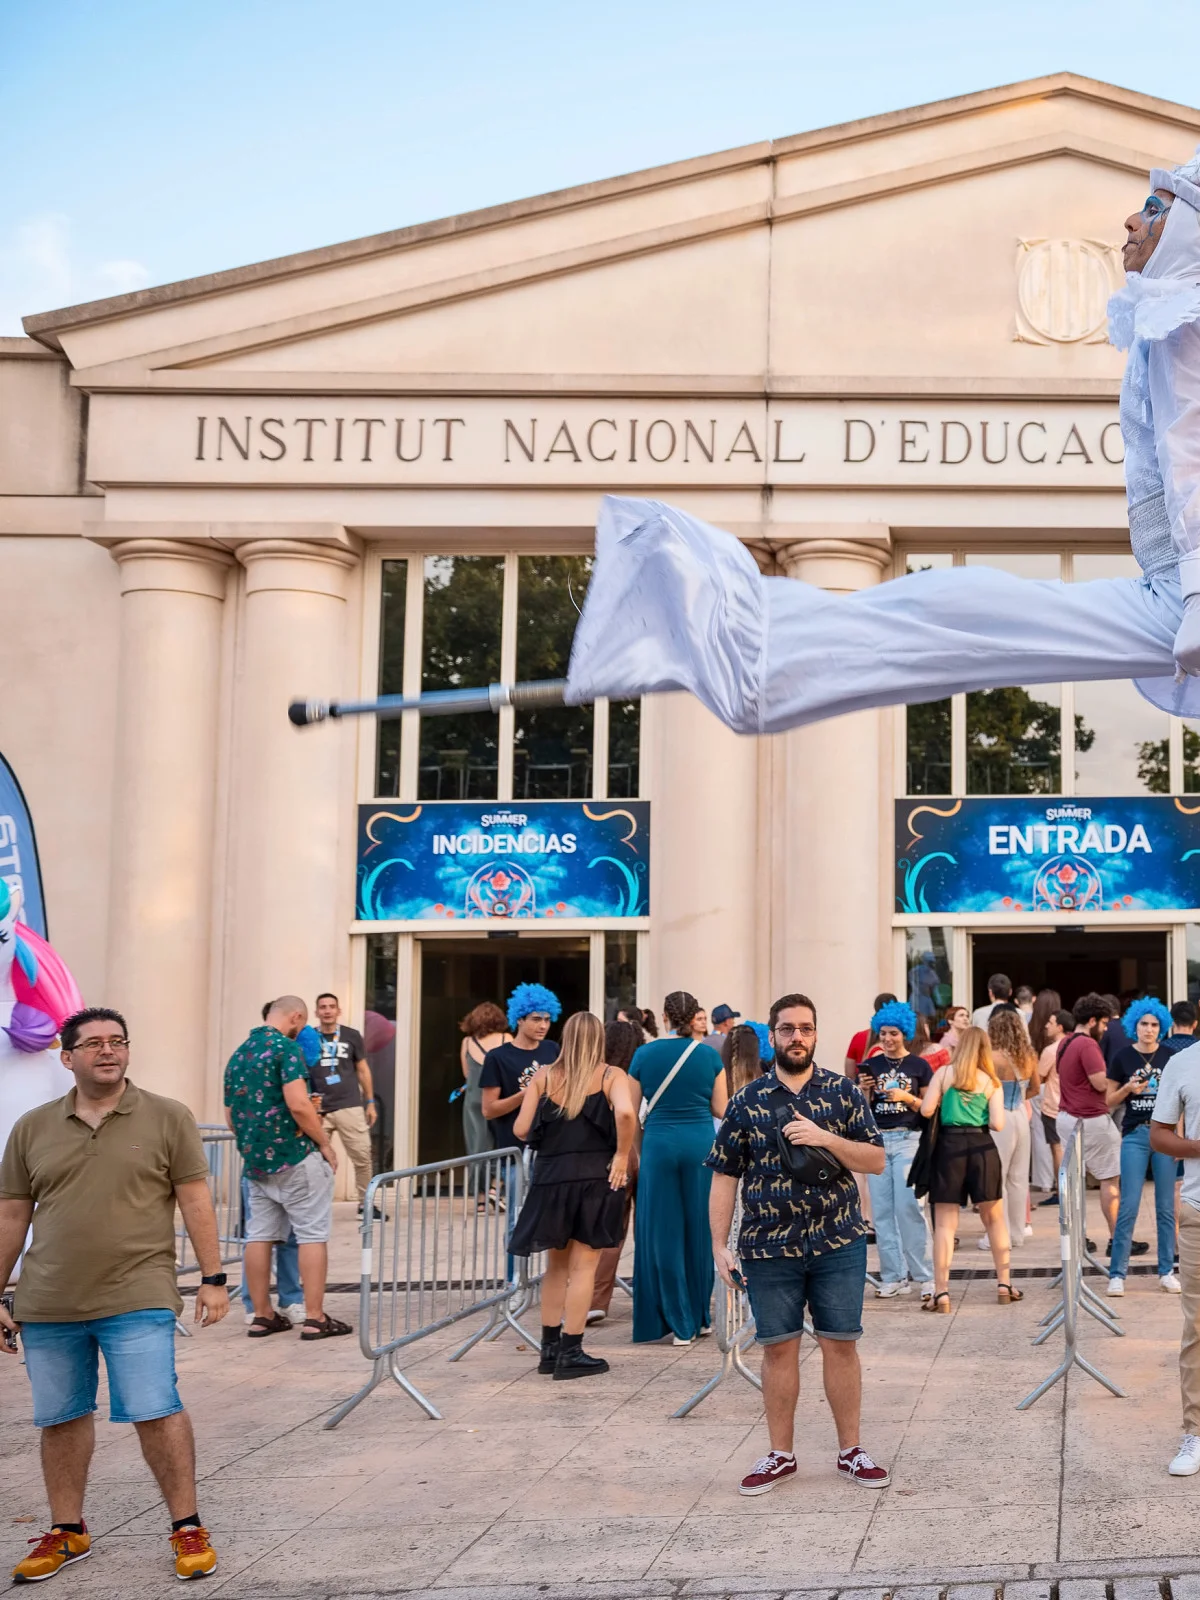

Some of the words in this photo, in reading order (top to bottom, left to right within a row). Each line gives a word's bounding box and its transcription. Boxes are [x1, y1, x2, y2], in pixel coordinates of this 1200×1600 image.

[194, 416, 466, 462] INSTITUT
[503, 417, 806, 463] NACIONAL
[843, 419, 1125, 465] D'EDUCAC
[481, 814, 528, 827] SUMMER
[1046, 808, 1092, 821] SUMMER
[432, 833, 577, 855] INCIDENCIAS
[989, 824, 1153, 855] ENTRADA
